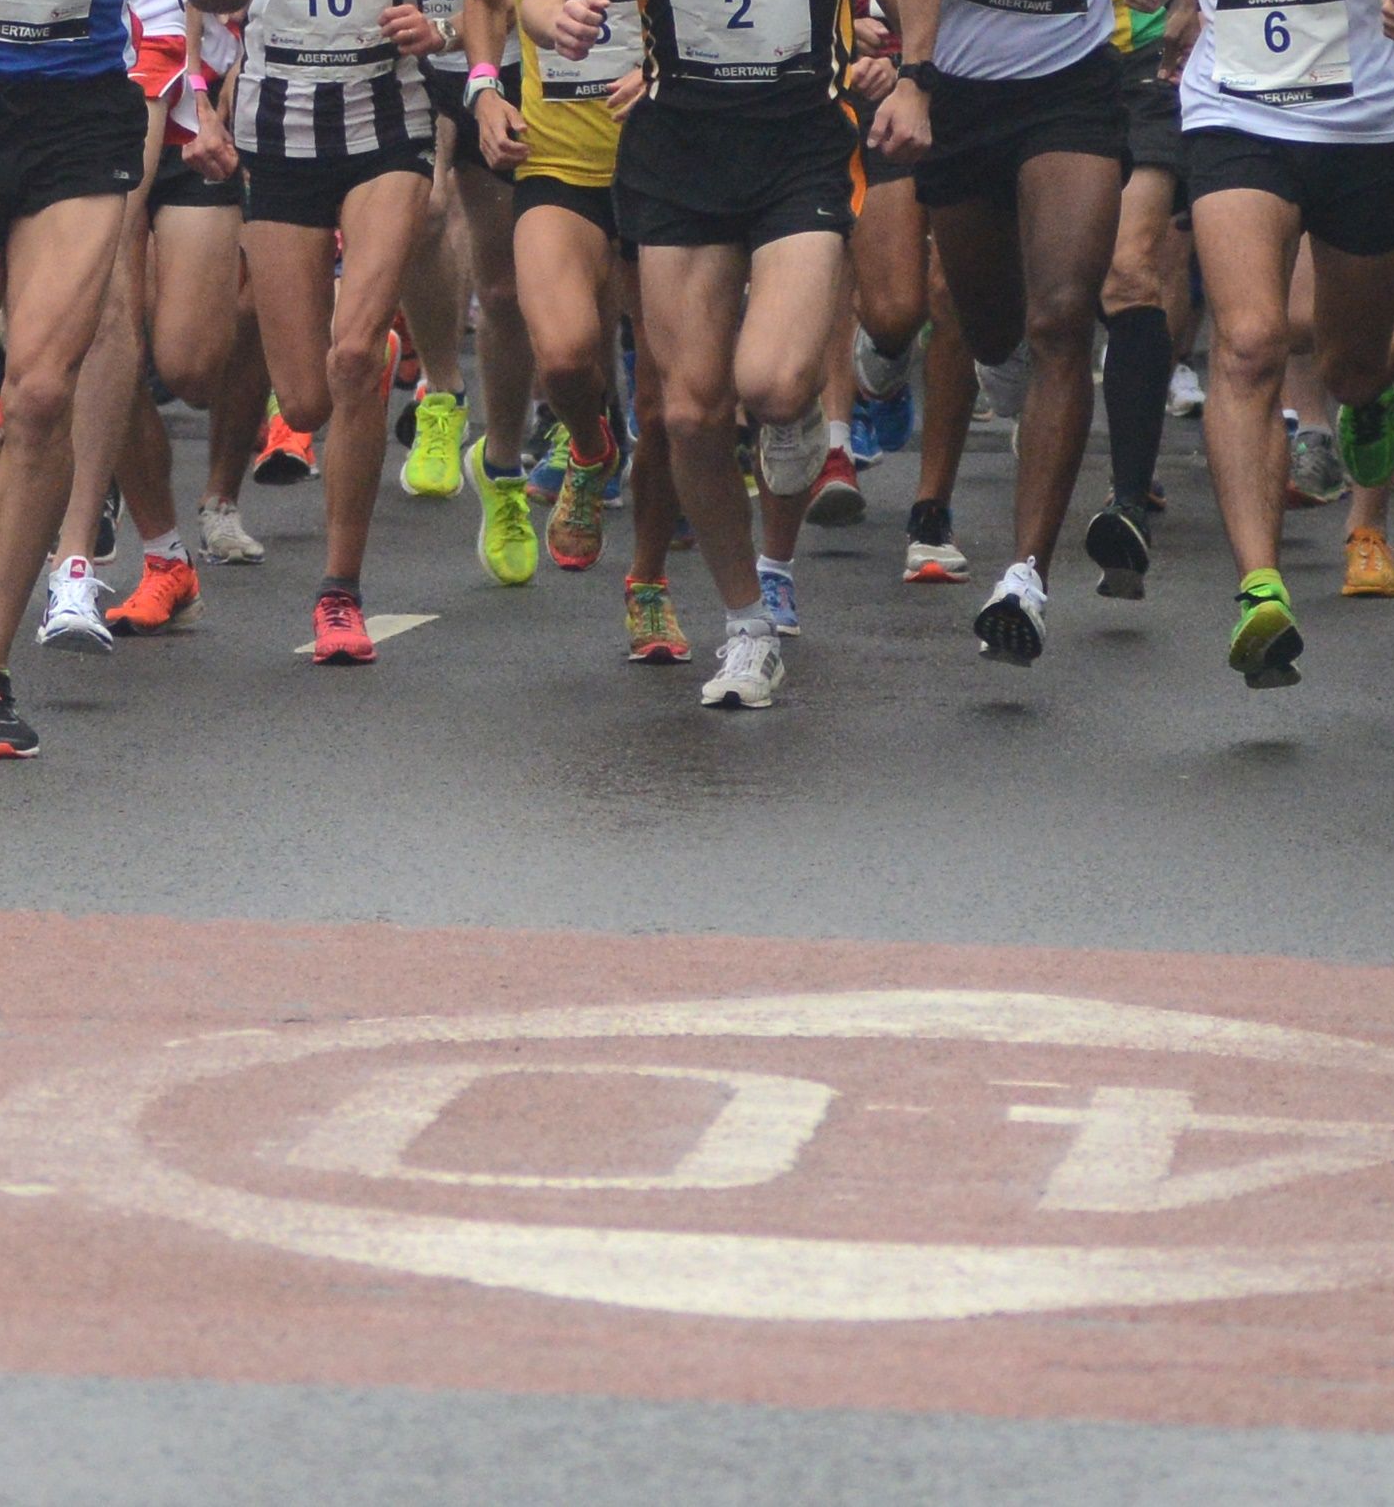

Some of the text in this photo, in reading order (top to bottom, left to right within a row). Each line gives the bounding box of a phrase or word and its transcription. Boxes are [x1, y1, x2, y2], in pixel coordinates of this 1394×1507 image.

[1263, 10, 1291, 53] 6
[296, 53, 358, 63] ABERTAWE
[713, 66, 778, 78] ABERTAWE
[574, 83, 607, 96] ABER
